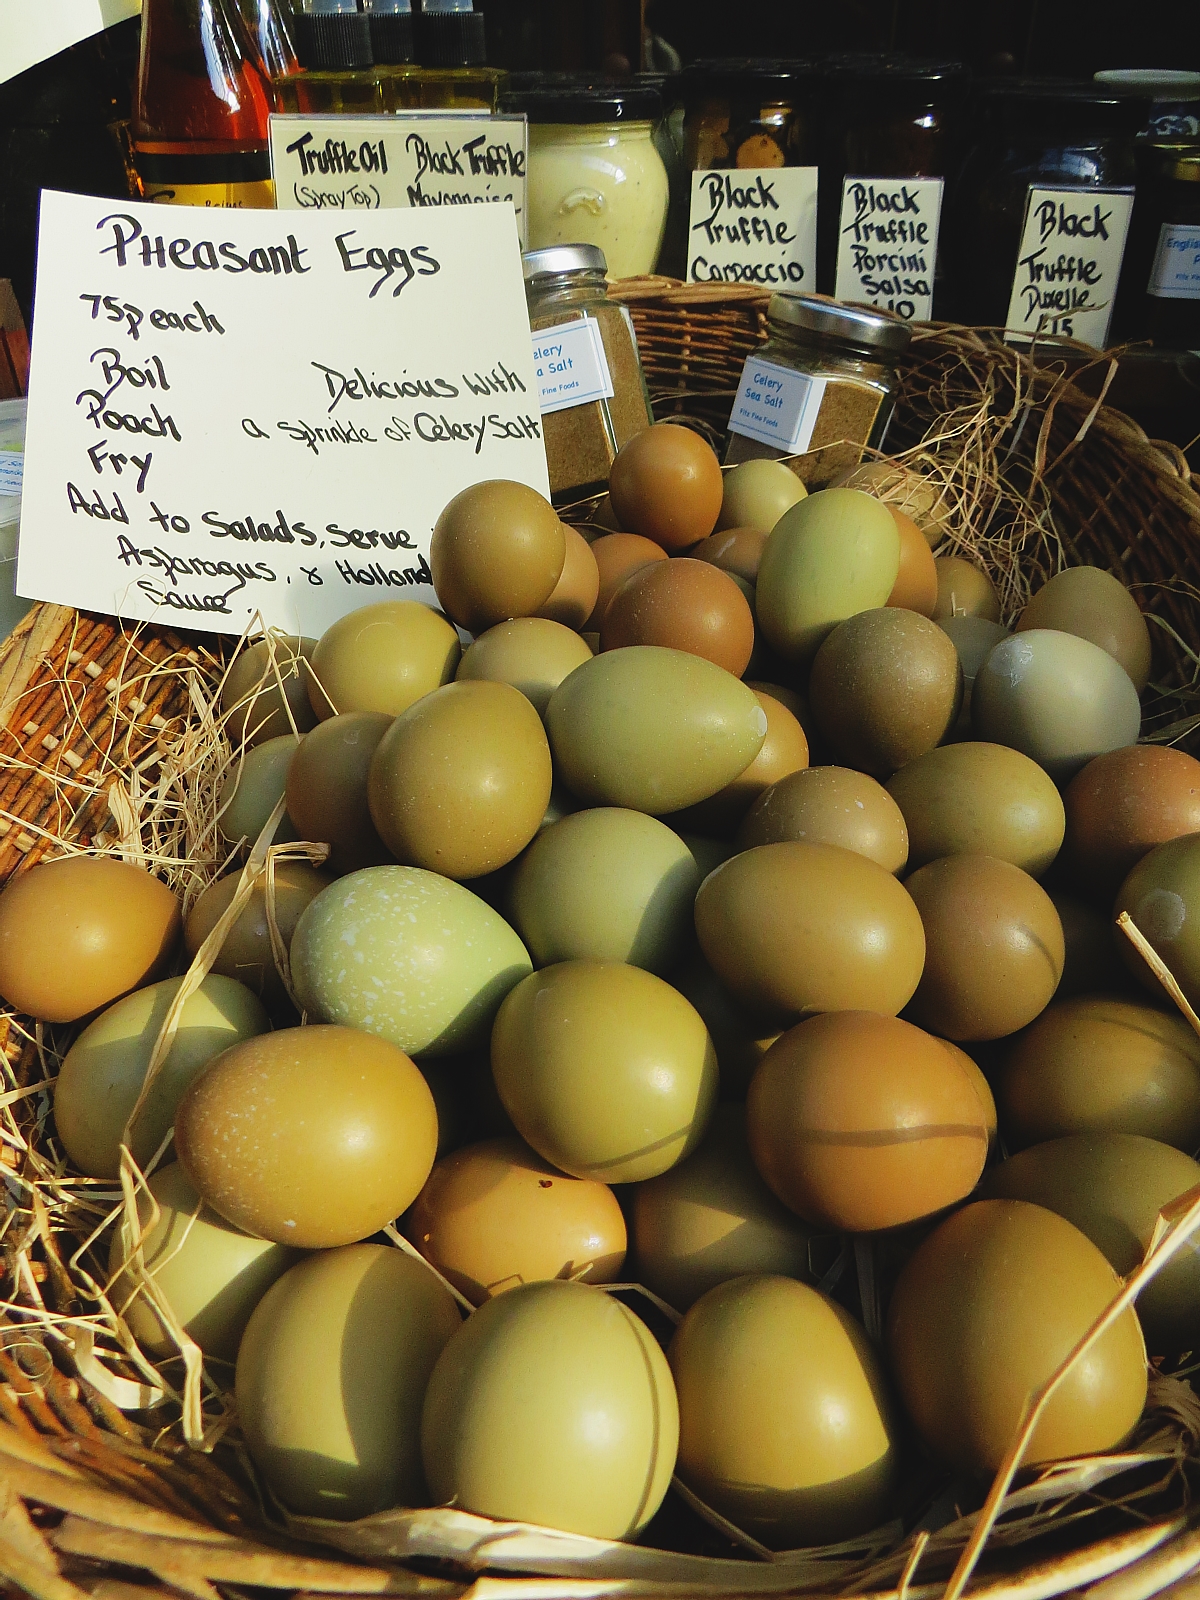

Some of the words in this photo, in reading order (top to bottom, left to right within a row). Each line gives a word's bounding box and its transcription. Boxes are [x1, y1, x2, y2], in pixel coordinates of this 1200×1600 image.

[286, 132, 360, 176] Truffle
[359, 139, 388, 174] Oil
[406, 133, 464, 183] Black
[463, 134, 526, 177] Truffle
[699, 172, 780, 223] Black
[846, 182, 921, 220] Black
[692, 216, 797, 246] Truffle
[842, 212, 930, 245] Truffle
[1033, 200, 1113, 244] Black
[335, 229, 441, 298] Eggs
[691, 250, 804, 283] Carpaccio
[850, 246, 927, 274] Porcini
[1019, 246, 1103, 285] Truffle
[860, 274, 931, 296] Salsa
[79, 293, 144, 341] 75p
[149, 300, 226, 335] each
[533, 344, 563, 360] elery
[548, 358, 573, 375] Salt
[89, 347, 171, 400] Boil
[310, 361, 460, 413] Delicious
[541, 387, 557, 397] Fine
[558, 380, 580, 392] Foods
[753, 372, 784, 393] Celery
[745, 387, 761, 402] Sea
[764, 394, 784, 409] Salt
[241, 417, 271, 439] a
[384, 415, 412, 442] of
[412, 411, 486, 454] Celery
[487, 414, 541, 440] Salt
[87, 439, 153, 494] Fry
[66, 481, 130, 524] Add
[149, 501, 191, 534] to
[335, 553, 433, 587] Holland
